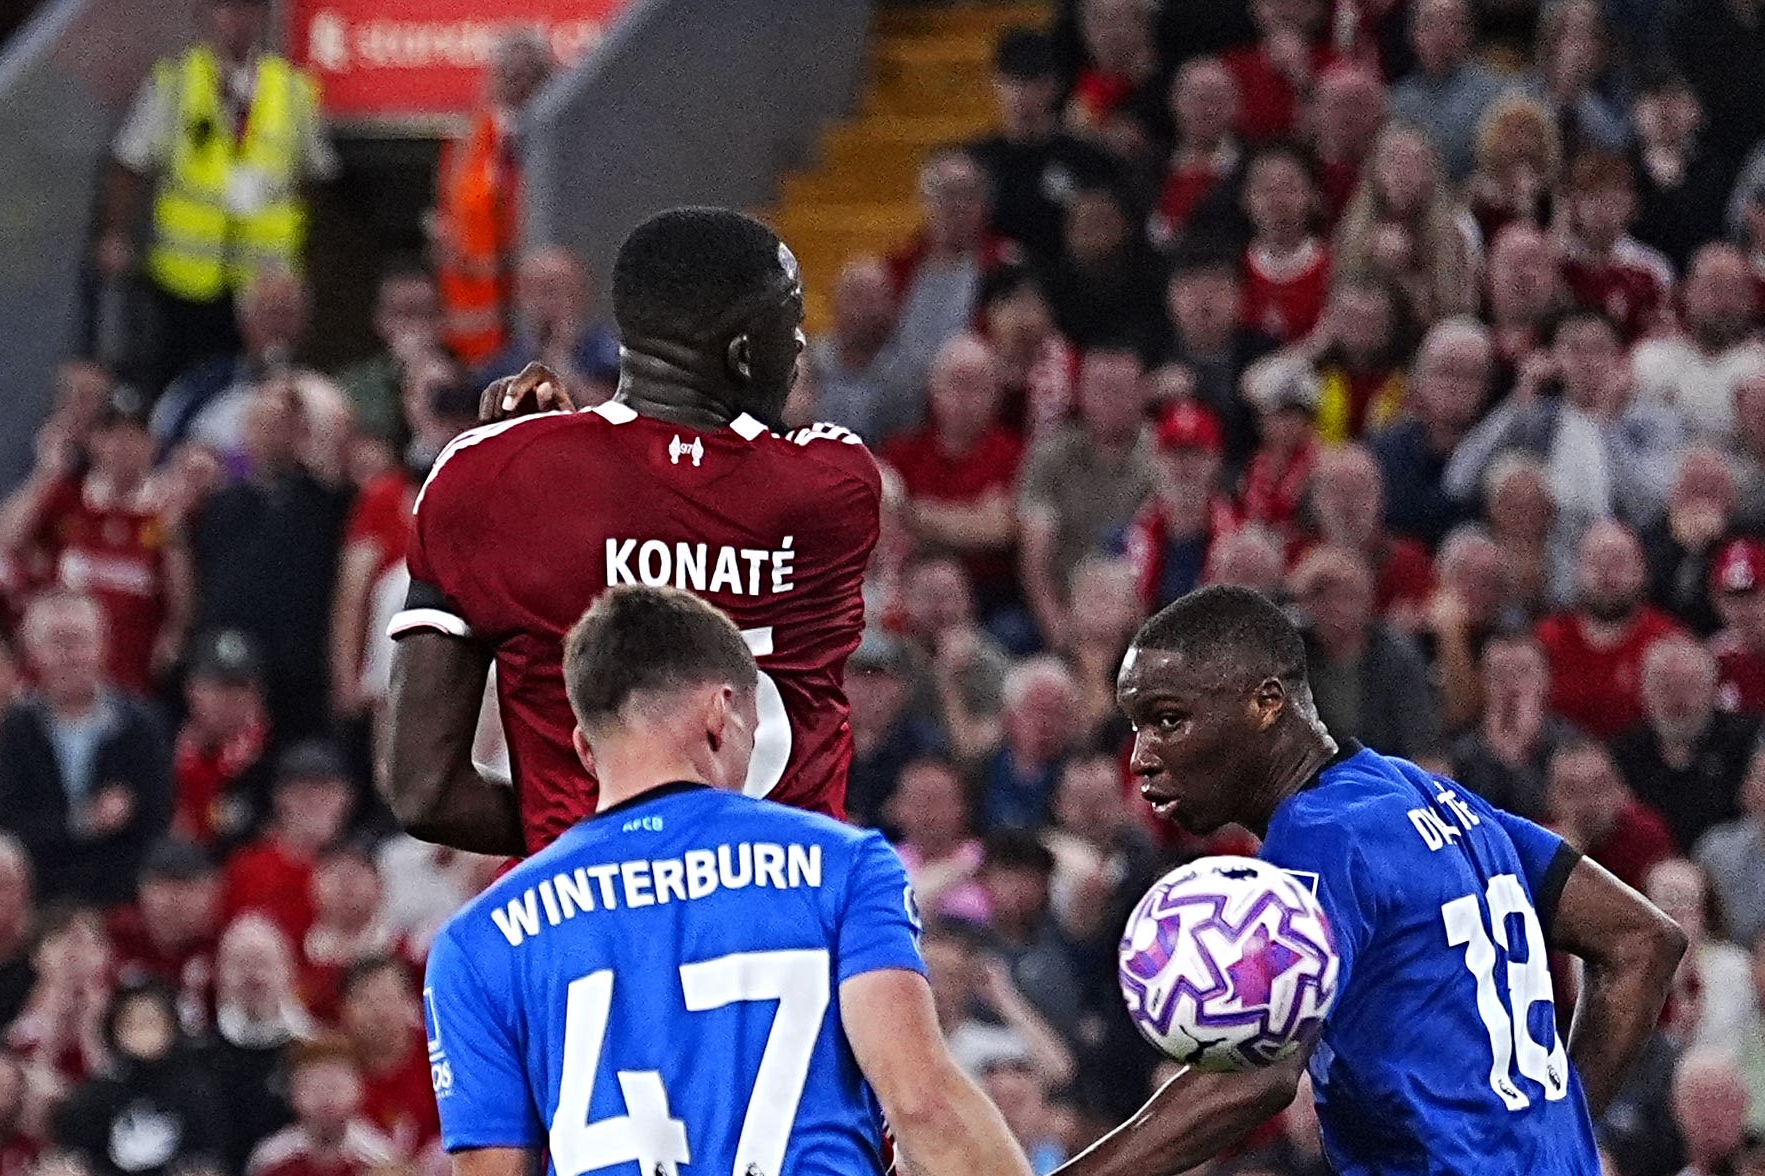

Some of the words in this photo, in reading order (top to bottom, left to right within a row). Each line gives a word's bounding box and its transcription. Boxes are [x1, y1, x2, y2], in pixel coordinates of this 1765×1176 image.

[605, 535, 796, 596] KONATÉ
[622, 815, 664, 833] AFCB
[491, 842, 823, 947] WINTERBURN
[1441, 873, 1569, 1112] 18
